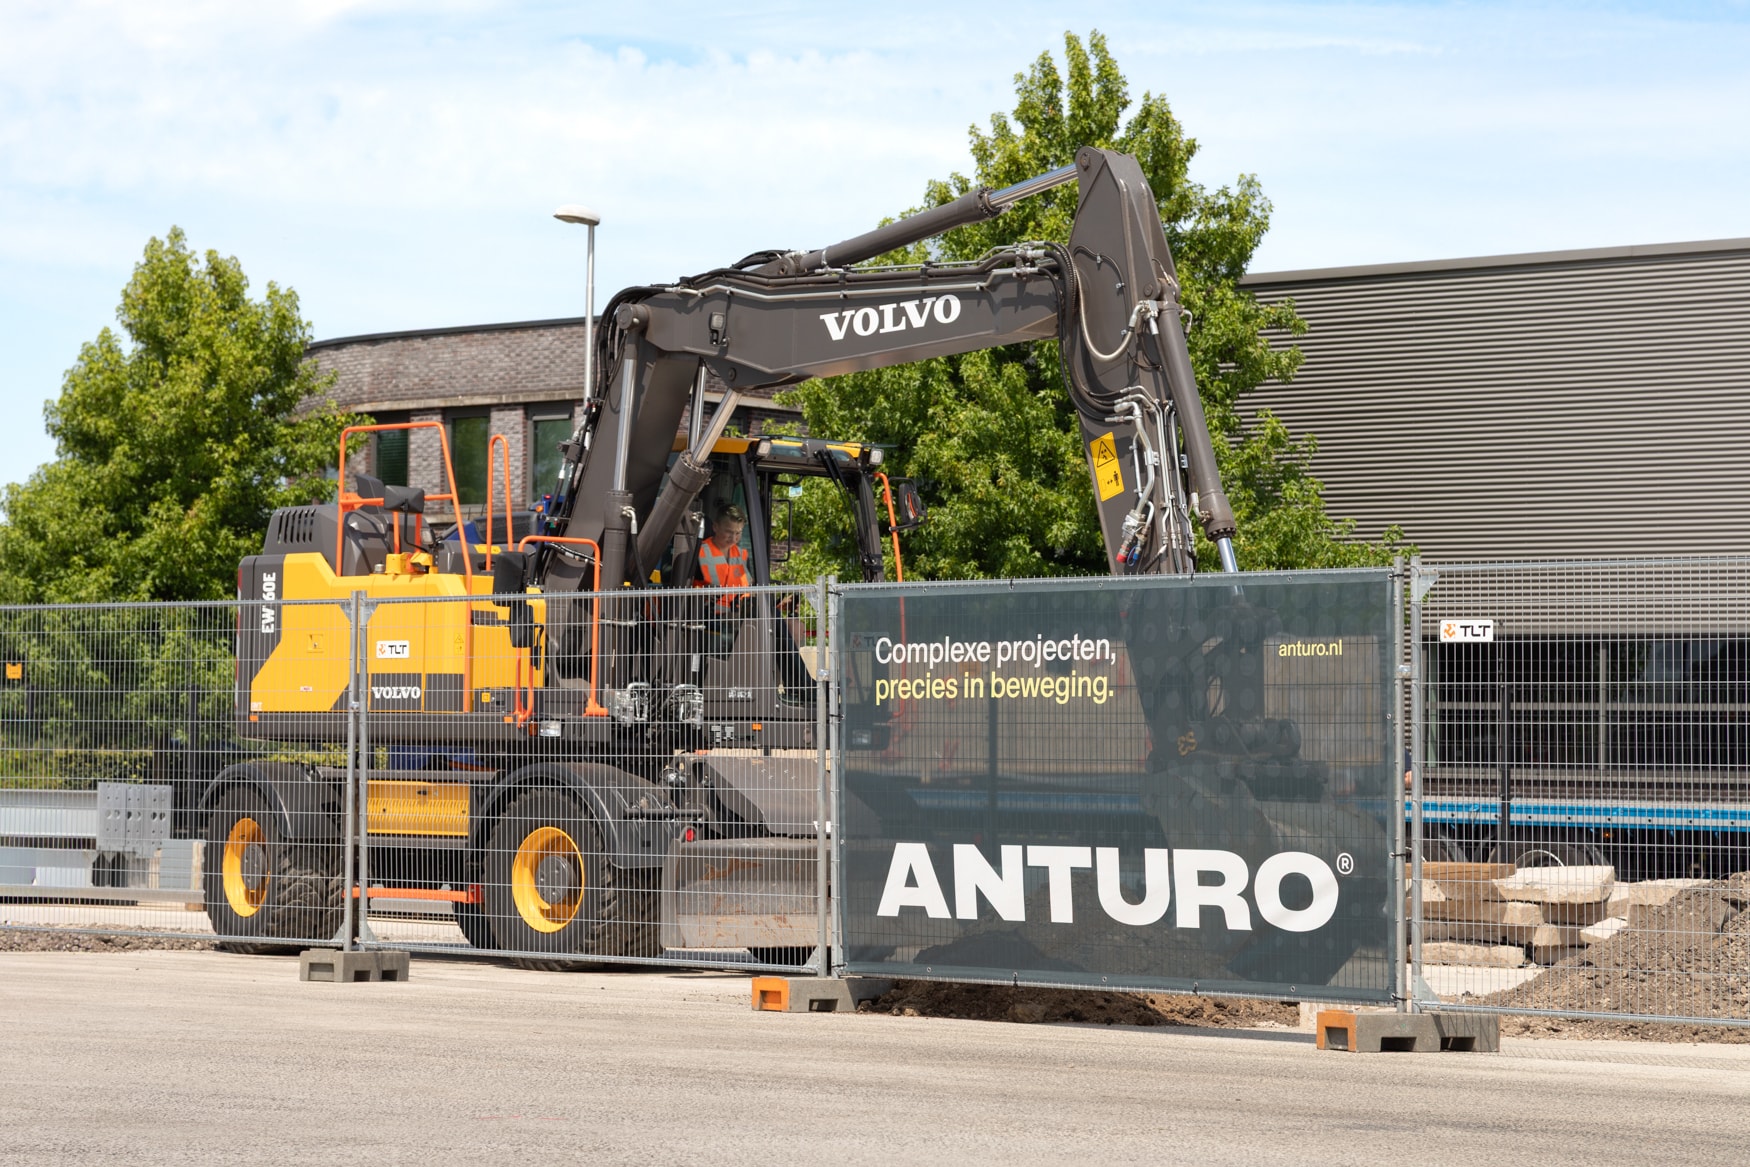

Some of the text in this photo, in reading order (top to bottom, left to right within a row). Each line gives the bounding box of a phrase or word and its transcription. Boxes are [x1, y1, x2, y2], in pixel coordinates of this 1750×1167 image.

[820, 294, 961, 341] VOLVO
[262, 572, 276, 633] EW60E
[1460, 625, 1491, 637] TLT
[388, 644, 407, 654] TLT
[876, 633, 1116, 669] Complexe projecten,
[1279, 639, 1343, 656] anturo.nl
[372, 686, 421, 699] VOLVO
[876, 669, 1114, 705] precies in beweging.
